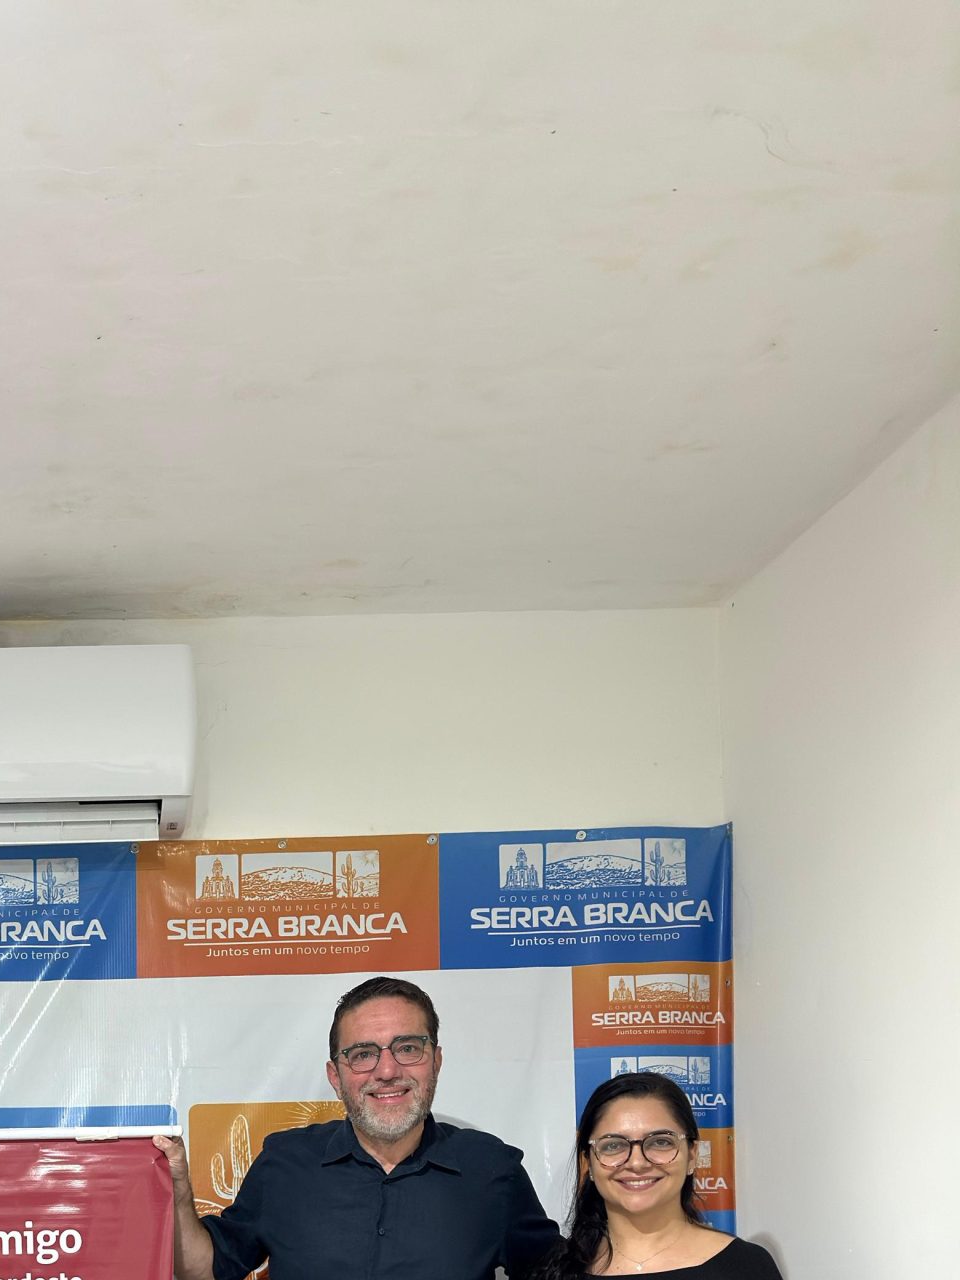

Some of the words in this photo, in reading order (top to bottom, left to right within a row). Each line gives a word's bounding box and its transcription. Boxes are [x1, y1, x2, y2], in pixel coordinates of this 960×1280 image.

[499, 894, 571, 903] GOVERNO
[577, 891, 664, 901] MUNICIPAL
[671, 889, 689, 898] DE
[195, 906, 266, 914] GOVERNO
[272, 903, 357, 913] MUNICIPAL
[363, 902, 380, 910] DE
[471, 906, 577, 929] SERRA
[584, 900, 714, 926] BRANCA
[167, 917, 272, 940] SERRA
[278, 912, 407, 937] BRANCA
[509, 936, 554, 947] Juntos
[558, 936, 577, 945] em
[580, 935, 600, 944] um
[604, 933, 635, 942] novo
[639, 931, 680, 943] tempo
[31, 951, 69, 961] tempo
[206, 947, 249, 957] Juntos
[253, 947, 271, 956] em
[274, 946, 292, 955] um
[296, 946, 327, 955] novo
[330, 944, 369, 955] tempo
[592, 1011, 655, 1026] SERRA
[658, 1011, 725, 1024] BRANCA
